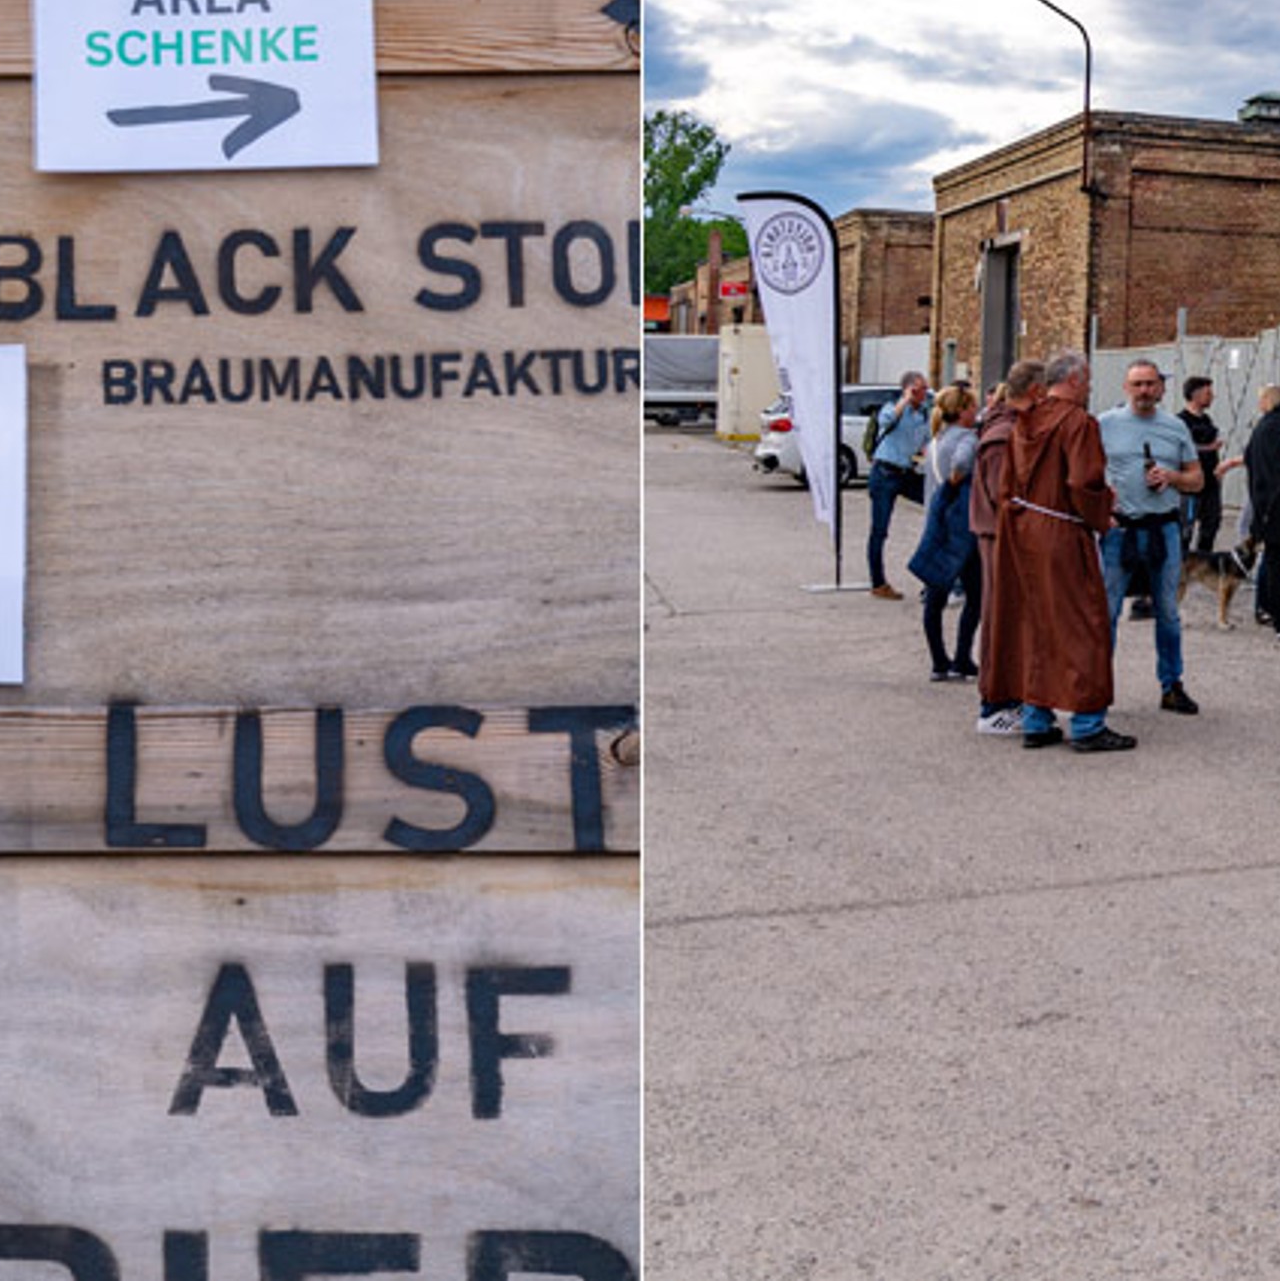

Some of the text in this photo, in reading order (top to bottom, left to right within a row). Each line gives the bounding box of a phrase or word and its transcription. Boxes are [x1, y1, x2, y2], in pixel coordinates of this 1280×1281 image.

[86, 25, 319, 67] SCHENKE
[413, 219, 641, 313] STO
[101, 347, 641, 406] BRAUMANUFAKTUR
[105, 698, 637, 851] LUST
[168, 960, 573, 1120] AUF
